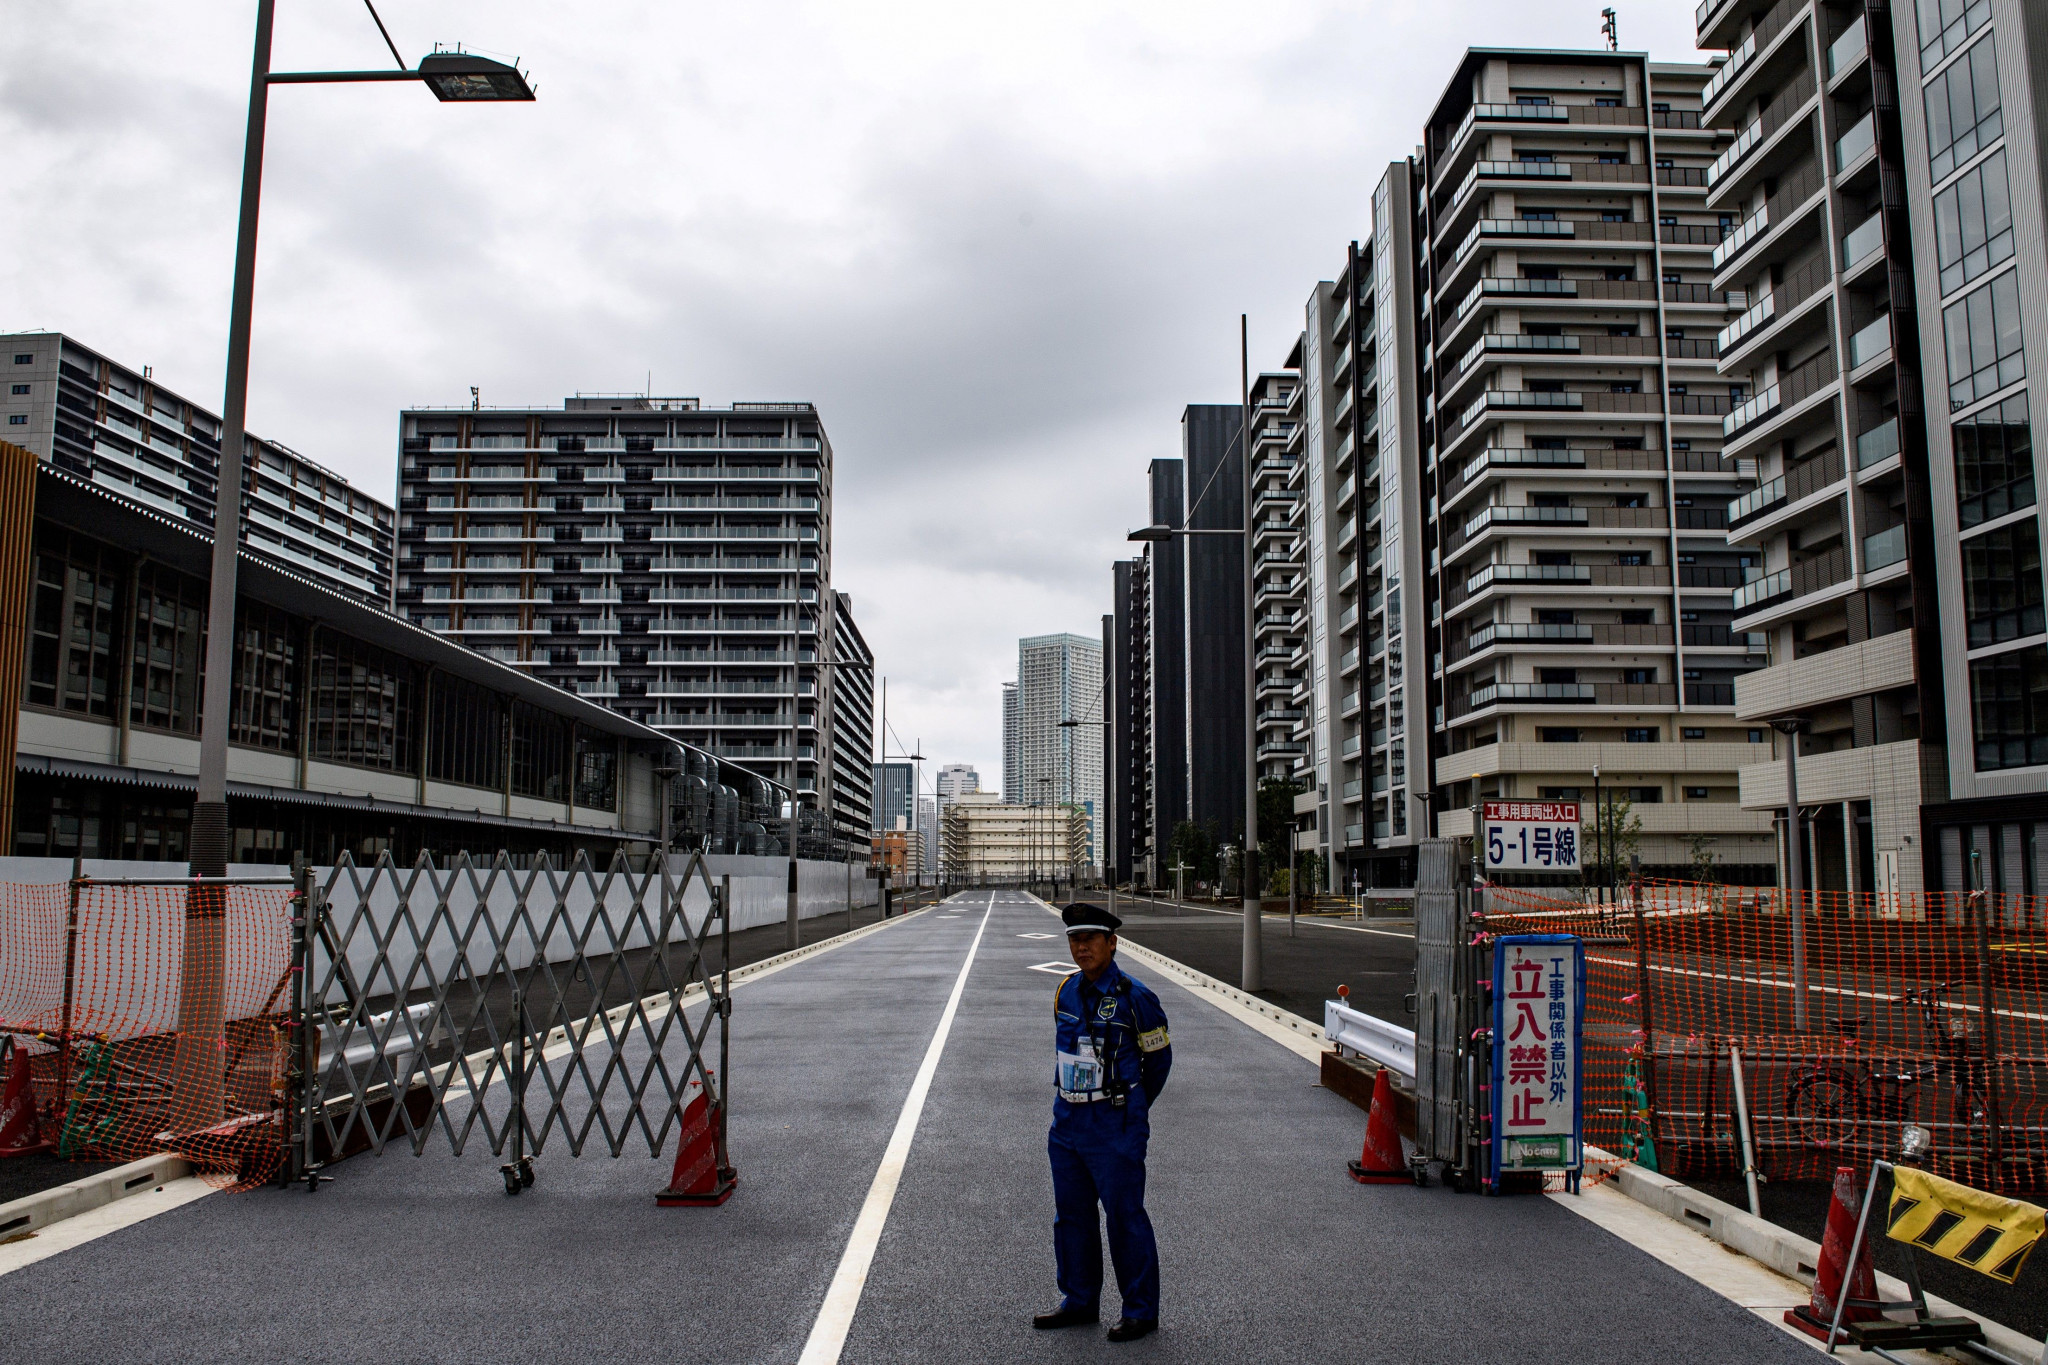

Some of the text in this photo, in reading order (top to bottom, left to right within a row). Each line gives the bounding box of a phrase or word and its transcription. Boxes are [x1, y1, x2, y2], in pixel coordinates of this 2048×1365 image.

[1487, 803, 1576, 820] 工事用車両出入口
[1488, 826, 1576, 866] 5-1号線
[1145, 1035, 1164, 1048] 1474
[1508, 958, 1547, 1127] 立入禁止
[1549, 957, 1567, 1103] 工事関係者以外
[1519, 1142, 1533, 1157] No
